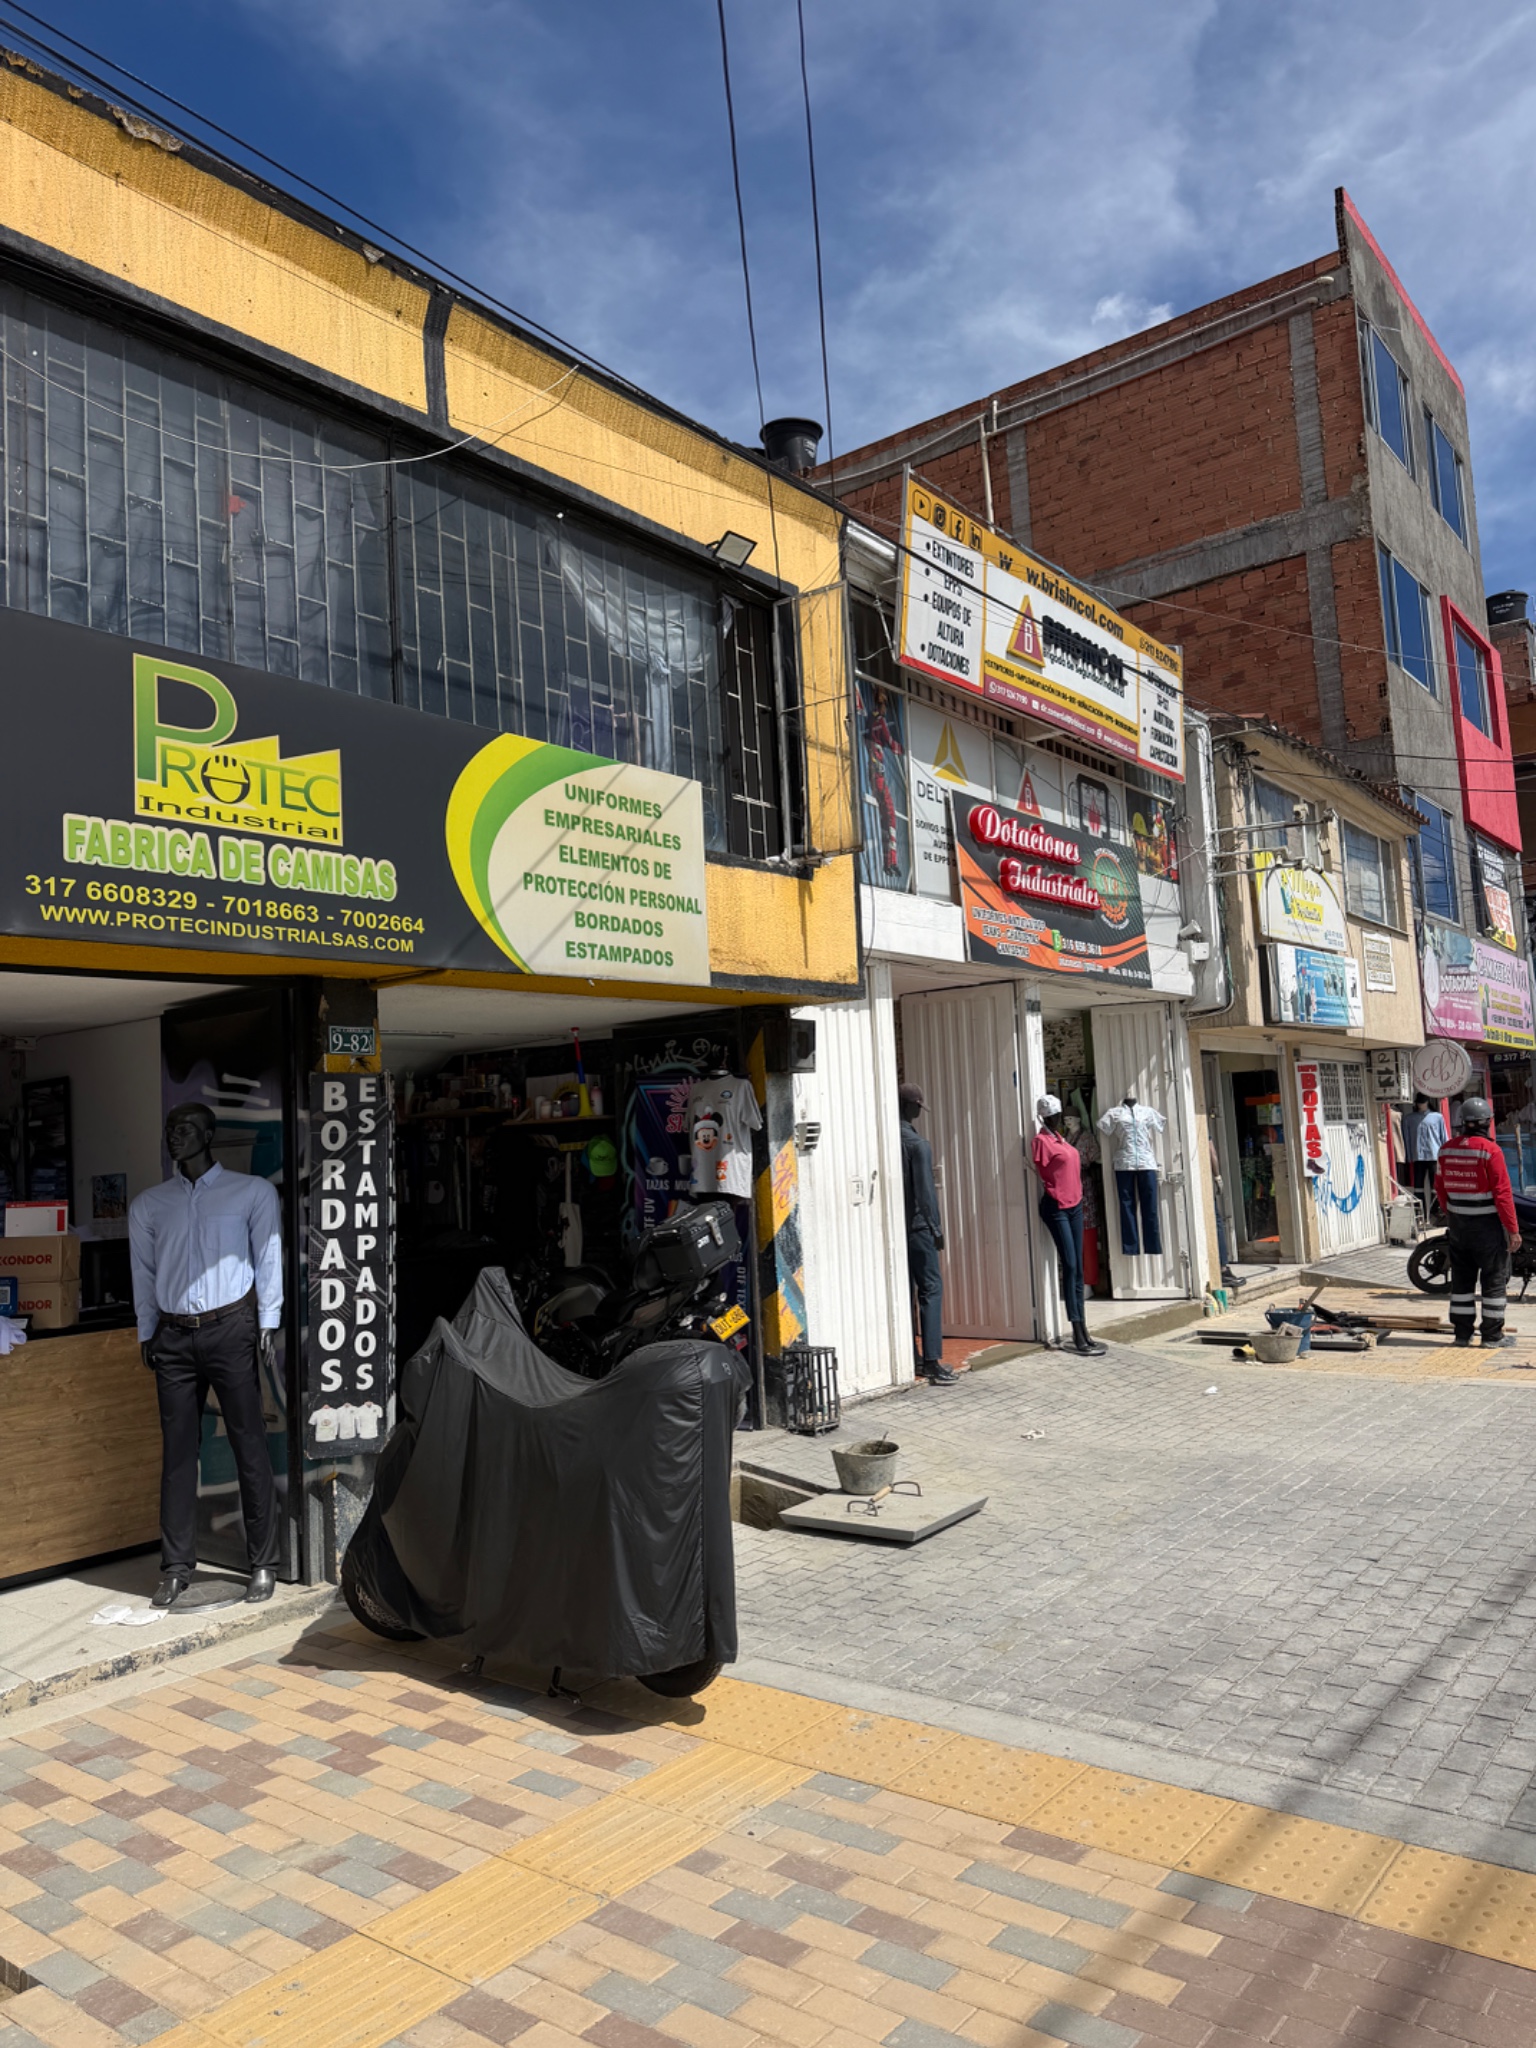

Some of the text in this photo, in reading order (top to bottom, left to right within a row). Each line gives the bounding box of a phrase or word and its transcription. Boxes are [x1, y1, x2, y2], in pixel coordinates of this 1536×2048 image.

[932, 541, 974, 579] EXTINTORES
[931, 591, 972, 627] EQUIPOS DE
[937, 621, 964, 648] ALTURA
[927, 641, 970, 676] DOTACIONES
[139, 795, 338, 840] Industrial
[564, 783, 662, 819] UNIFORMES
[544, 809, 681, 851] EMPRESARIALES
[973, 805, 1082, 864] Dotaciones
[64, 814, 397, 900] FABRICA DE CAMISAS
[559, 845, 672, 880] ELEMENTOS DE
[523, 872, 702, 915] PROTECCIÓN PERSONAL
[1003, 859, 1101, 908] Industriales
[25, 874, 77, 898] 317
[86, 881, 198, 910] 6608329
[222, 896, 319, 923] 7018663
[340, 909, 425, 934] 7002664
[40, 904, 414, 953] WWW.PROTECINDUSTRIALSAS.COM
[574, 910, 664, 937] BORDADOS
[566, 941, 674, 967] ESTAMPADOS
[1440, 974, 1478, 993] DOTACIONES
[332, 1032, 370, 1053] 9-82
[1301, 1073, 1322, 1159] BOTAS
[646, 1179, 669, 1191] TAZAS
[318, 1081, 348, 1392] BORDADOS
[354, 1077, 378, 1391] ESTAMPADOS
[18, 1299, 52, 1311] NDOR
